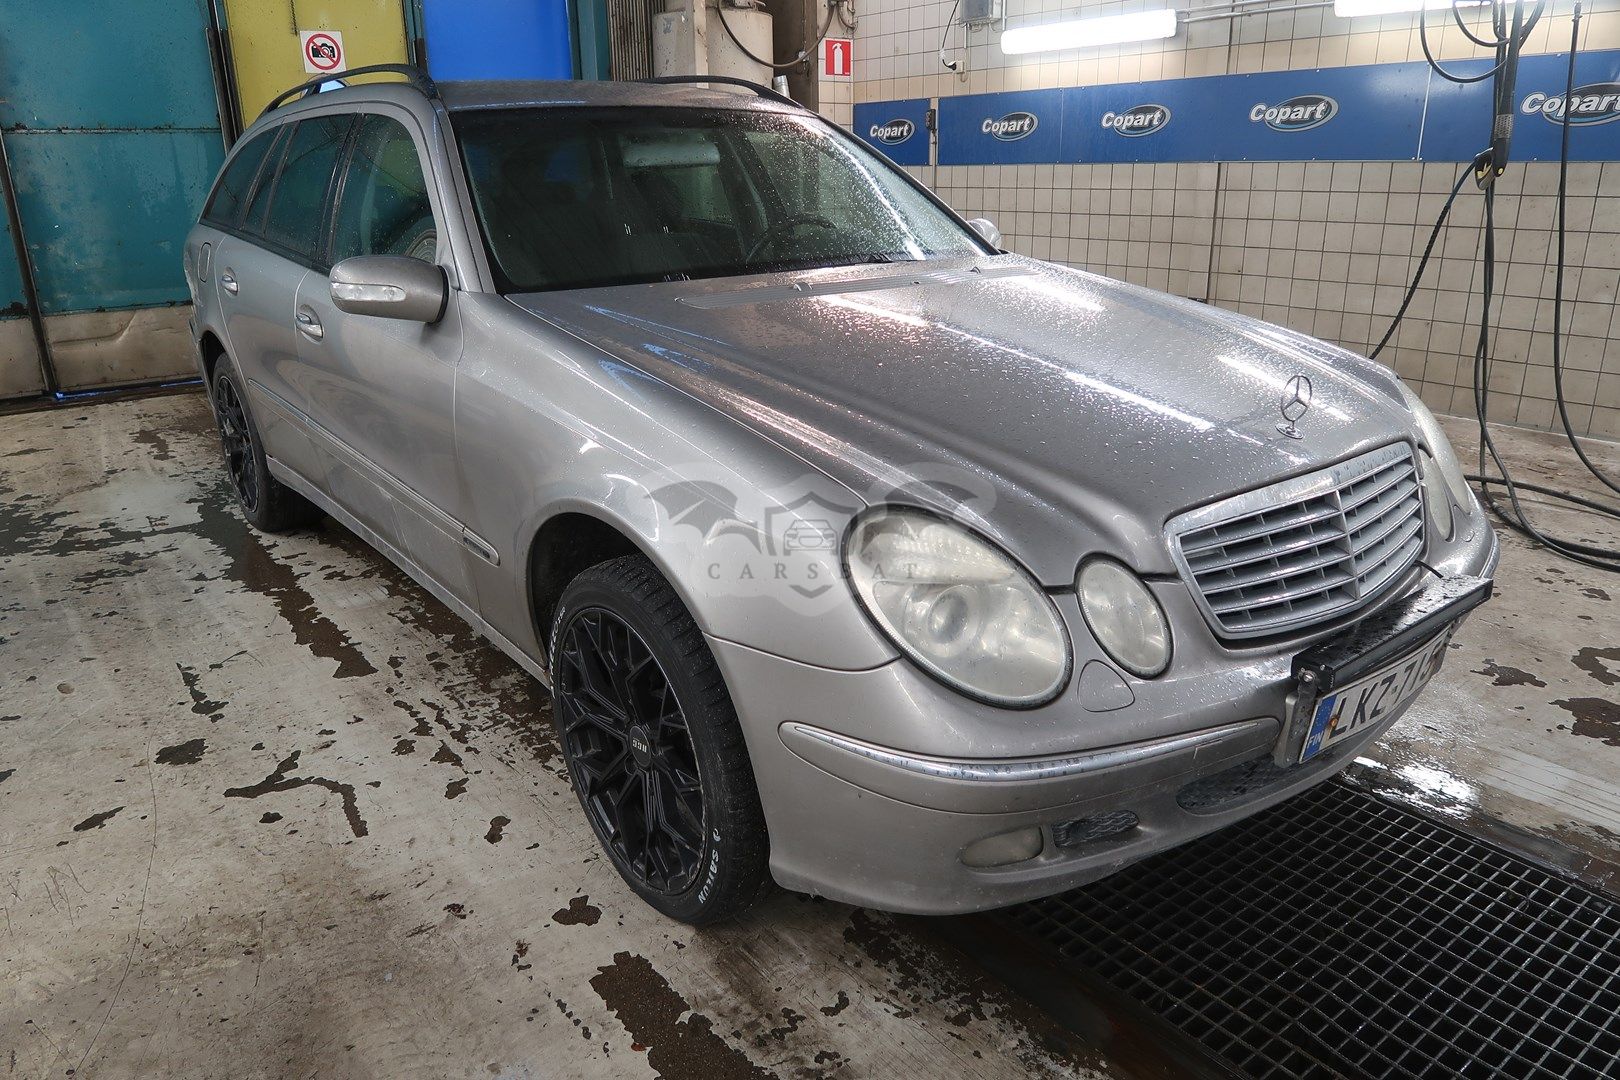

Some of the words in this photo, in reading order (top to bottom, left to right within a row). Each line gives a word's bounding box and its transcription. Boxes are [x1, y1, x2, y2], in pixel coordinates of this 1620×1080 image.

[1102, 109, 1163, 129] Copart
[1250, 100, 1328, 124] Copart
[870, 121, 910, 140] Copart
[982, 117, 1032, 138] Copart
[1306, 730, 1324, 749] FIN
